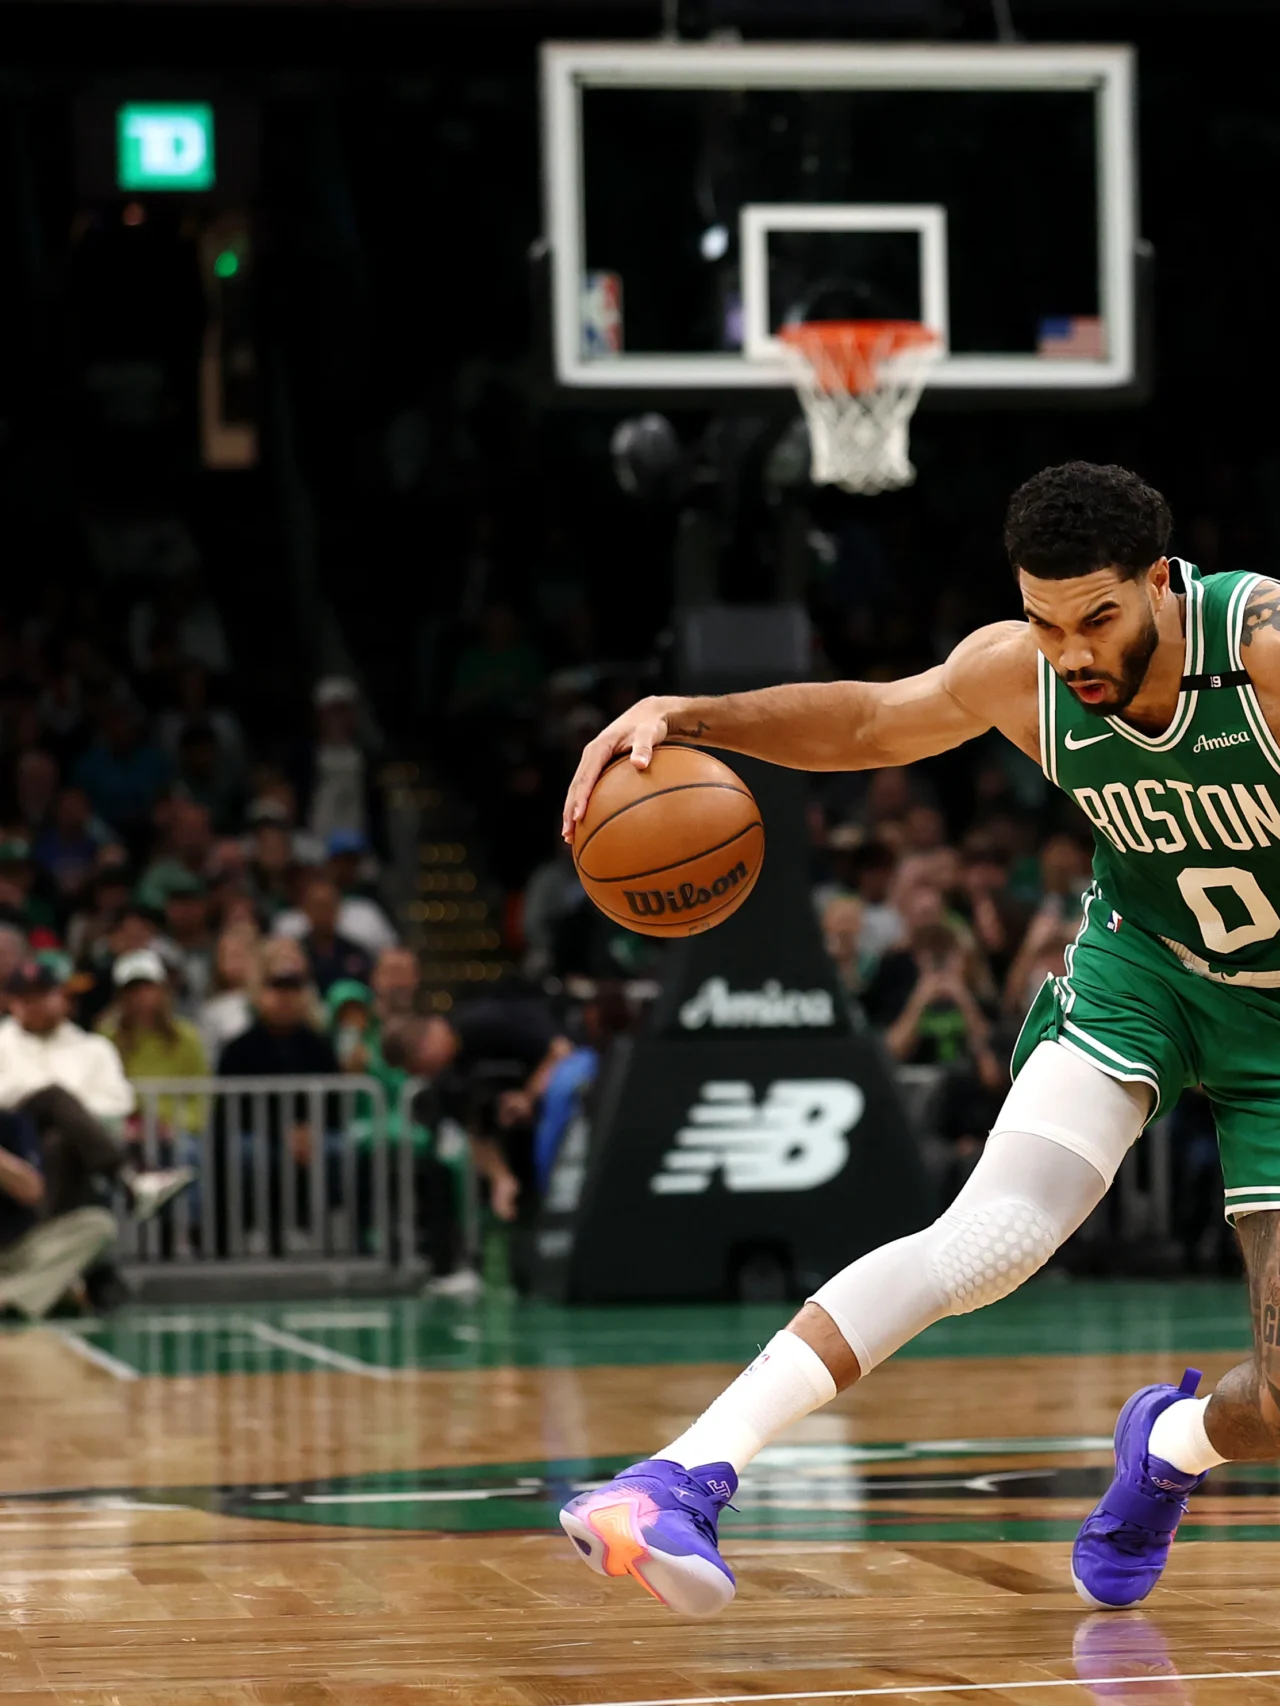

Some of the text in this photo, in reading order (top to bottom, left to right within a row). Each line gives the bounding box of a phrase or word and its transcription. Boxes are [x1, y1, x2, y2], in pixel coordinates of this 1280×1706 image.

[126, 115, 206, 175] TD
[1193, 731, 1251, 753] Amica
[622, 860, 748, 917] Wilson
[679, 977, 835, 1030] Amica
